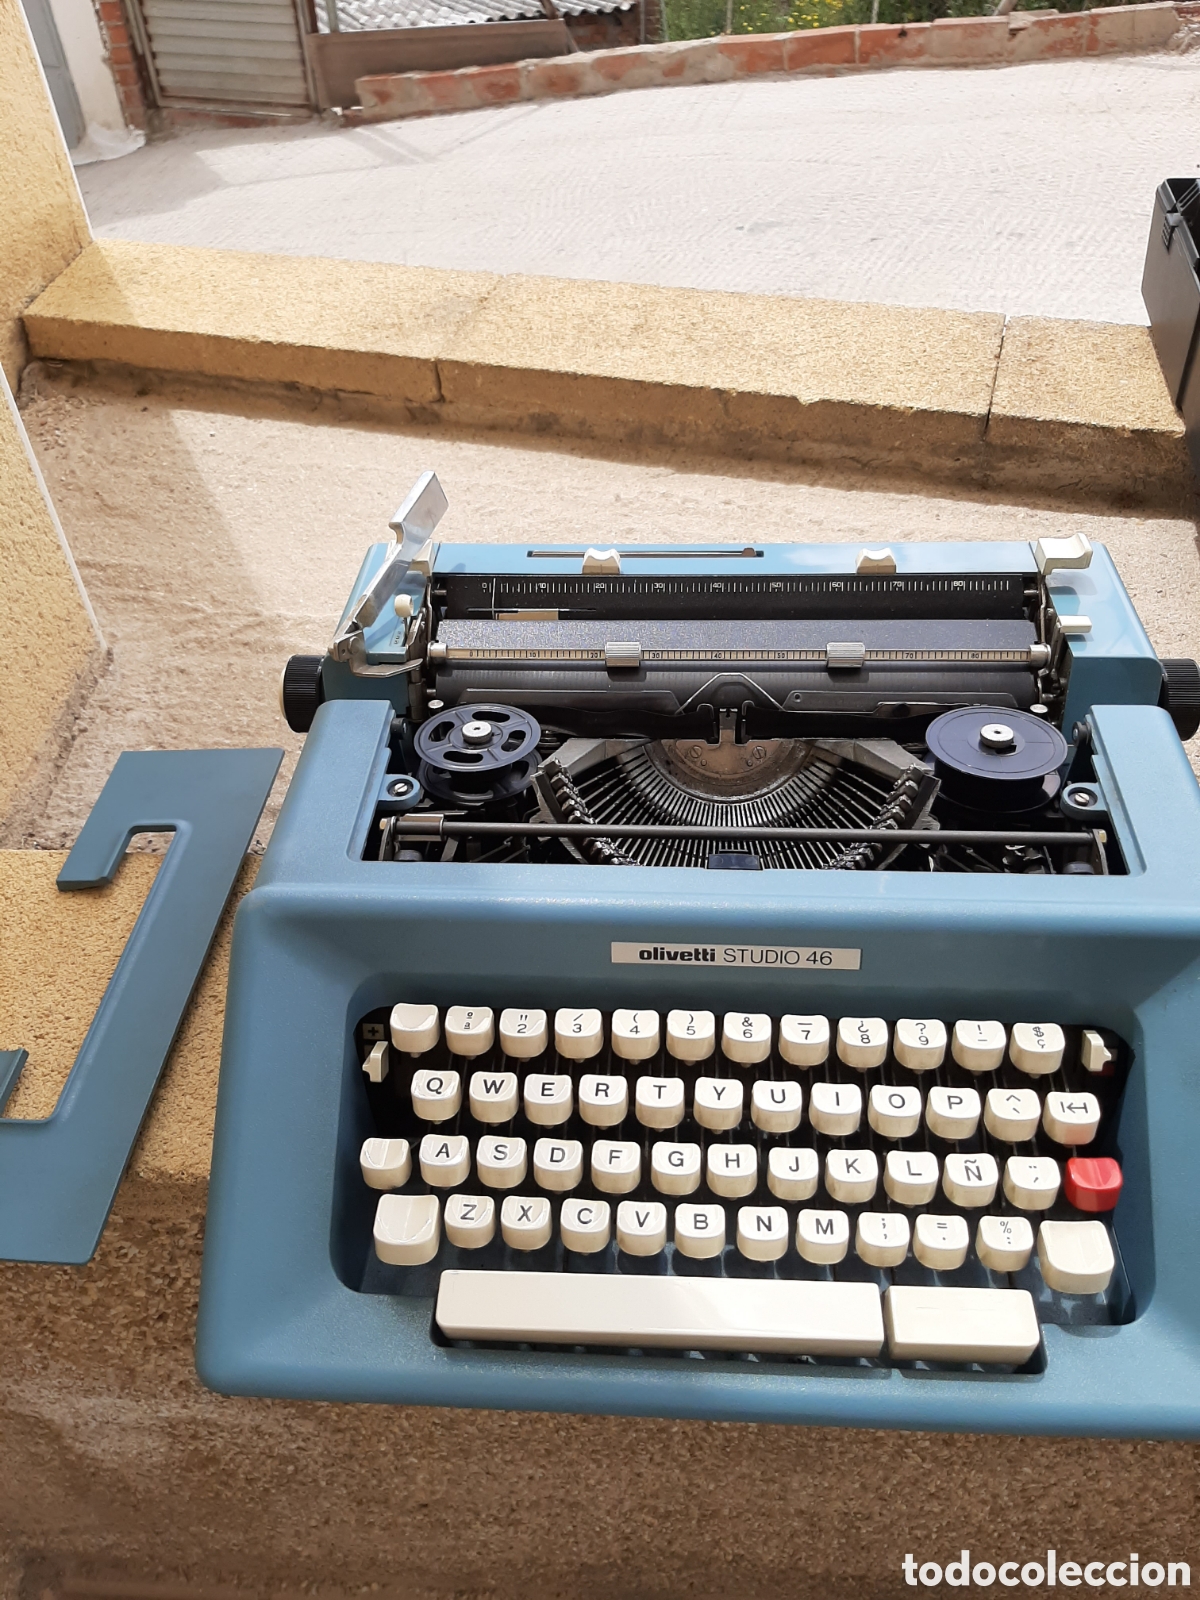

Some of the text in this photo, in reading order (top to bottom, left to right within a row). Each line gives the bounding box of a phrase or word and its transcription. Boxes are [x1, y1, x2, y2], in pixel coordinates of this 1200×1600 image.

[638, 947, 833, 966] olivetti STUDIO 46
[517, 1024, 527, 1034] 2
[573, 1024, 582, 1034] 3
[630, 1026, 641, 1035] 4
[687, 1026, 696, 1036] 5
[743, 1029, 753, 1039] 6
[802, 1030, 811, 1041] 7
[861, 1034, 871, 1045] 8
[919, 1036, 930, 1046] 9
[427, 1078, 444, 1095] Q
[484, 1079, 505, 1095] W
[541, 1083, 556, 1097] E
[595, 1083, 610, 1098] R
[653, 1085, 667, 1100] T
[713, 1086, 726, 1101] Y
[771, 1089, 786, 1104] U
[889, 1094, 906, 1109] O
[947, 1096, 963, 1110] P
[436, 1143, 983, 1182] A S D F G H J K L Ñ
[461, 1204, 834, 1235] Z X C V B N M
